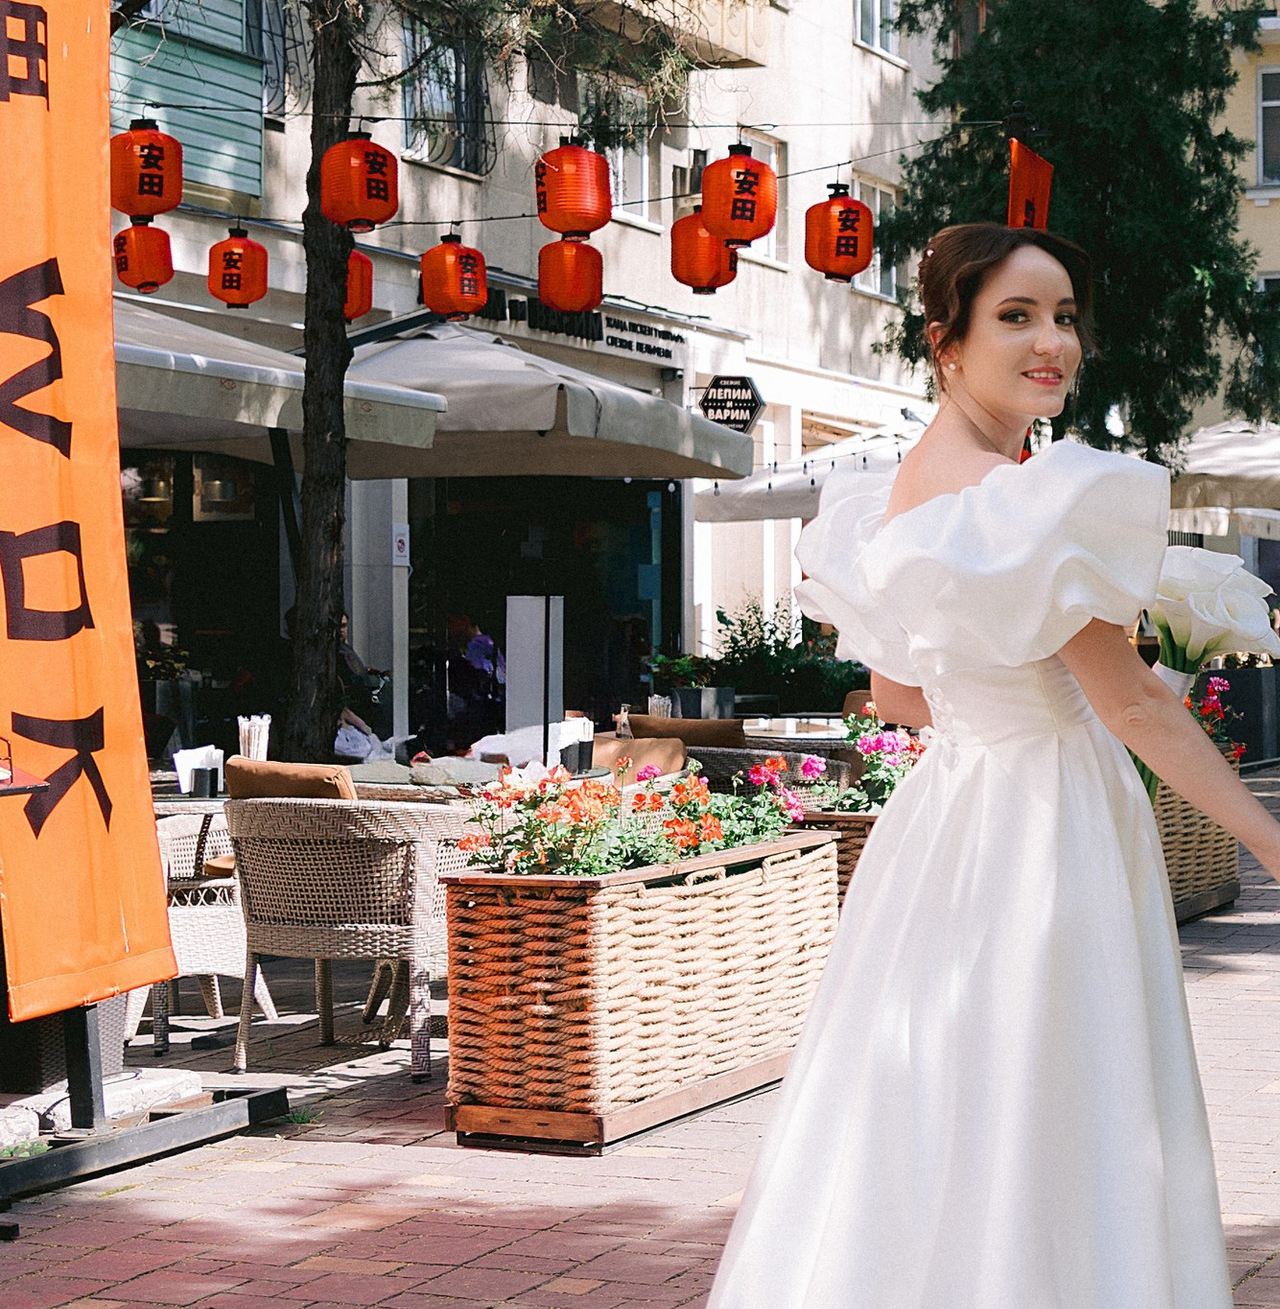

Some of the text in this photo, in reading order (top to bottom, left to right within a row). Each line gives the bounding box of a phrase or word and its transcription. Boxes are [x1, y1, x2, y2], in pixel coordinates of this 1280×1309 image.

[138, 143, 164, 197] 安田
[364, 150, 389, 203] 安田
[731, 169, 759, 222] 安田
[835, 207, 860, 257] 安田
[222, 251, 243, 291] 安田
[458, 254, 479, 297] 安田
[707, 408, 751, 420] ВАРИМ
[708, 388, 752, 400] ЛЕПИМ
